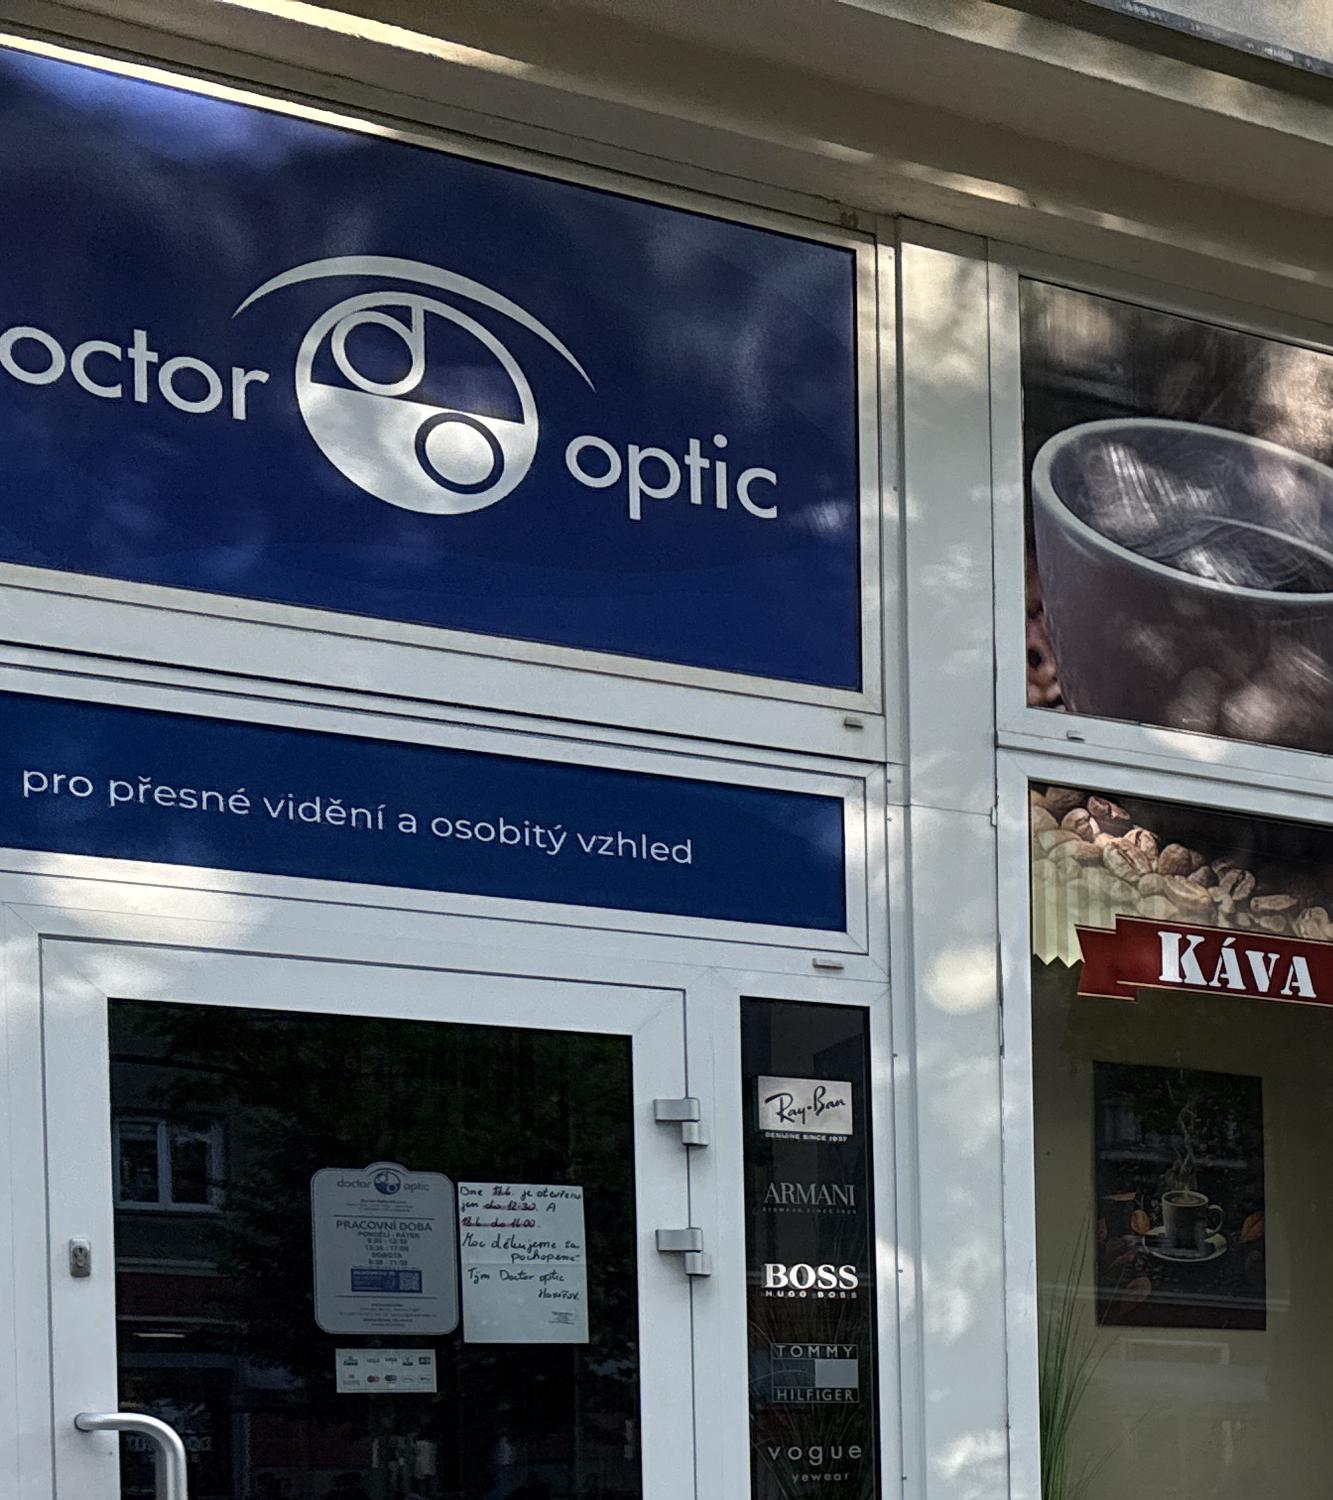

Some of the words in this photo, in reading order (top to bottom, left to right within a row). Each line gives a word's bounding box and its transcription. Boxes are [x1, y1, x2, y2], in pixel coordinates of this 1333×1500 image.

[565, 433, 779, 521] optic
[21, 768, 93, 800] pro
[107, 775, 250, 815] přesné
[262, 793, 385, 832] vidění
[397, 813, 418, 835] a
[430, 815, 565, 854] osobitý
[576, 831, 693, 866] vzhled
[1157, 930, 1317, 998] KÁVA
[764, 1085, 847, 1125] Ray-Ban
[337, 1177, 372, 1189] doctor
[764, 1181, 856, 1207] ARMANI
[546, 1202, 557, 1213] A
[335, 1219, 397, 1231] PRACOVNÍ
[399, 1221, 433, 1232] DOBA
[764, 1263, 859, 1290] BOSS
[765, 1290, 808, 1298] HUGO
[817, 1290, 858, 1299] BOSS
[776, 1345, 854, 1358] TOMMY
[777, 1388, 855, 1401] HILFIGER
[767, 1445, 862, 1467] vogue
